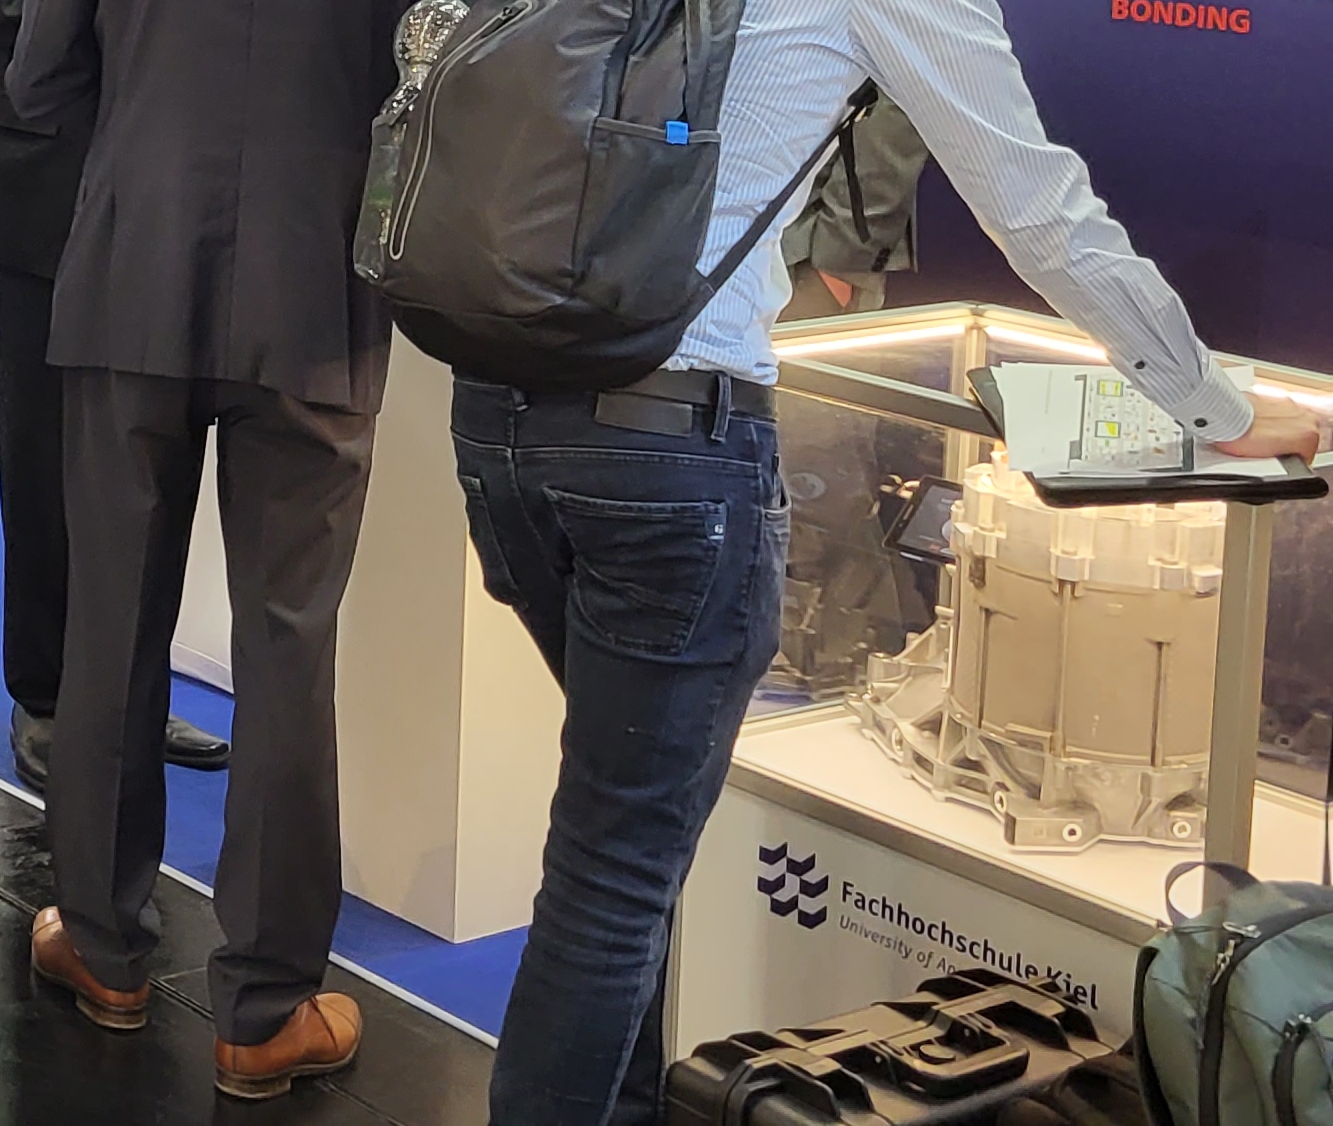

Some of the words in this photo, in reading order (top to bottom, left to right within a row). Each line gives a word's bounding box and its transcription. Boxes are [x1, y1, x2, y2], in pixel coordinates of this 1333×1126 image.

[839, 914, 913, 961] University
[916, 949, 933, 968] of
[841, 880, 1039, 981] Fachhochschule
[1046, 965, 1099, 1011] Kiel
